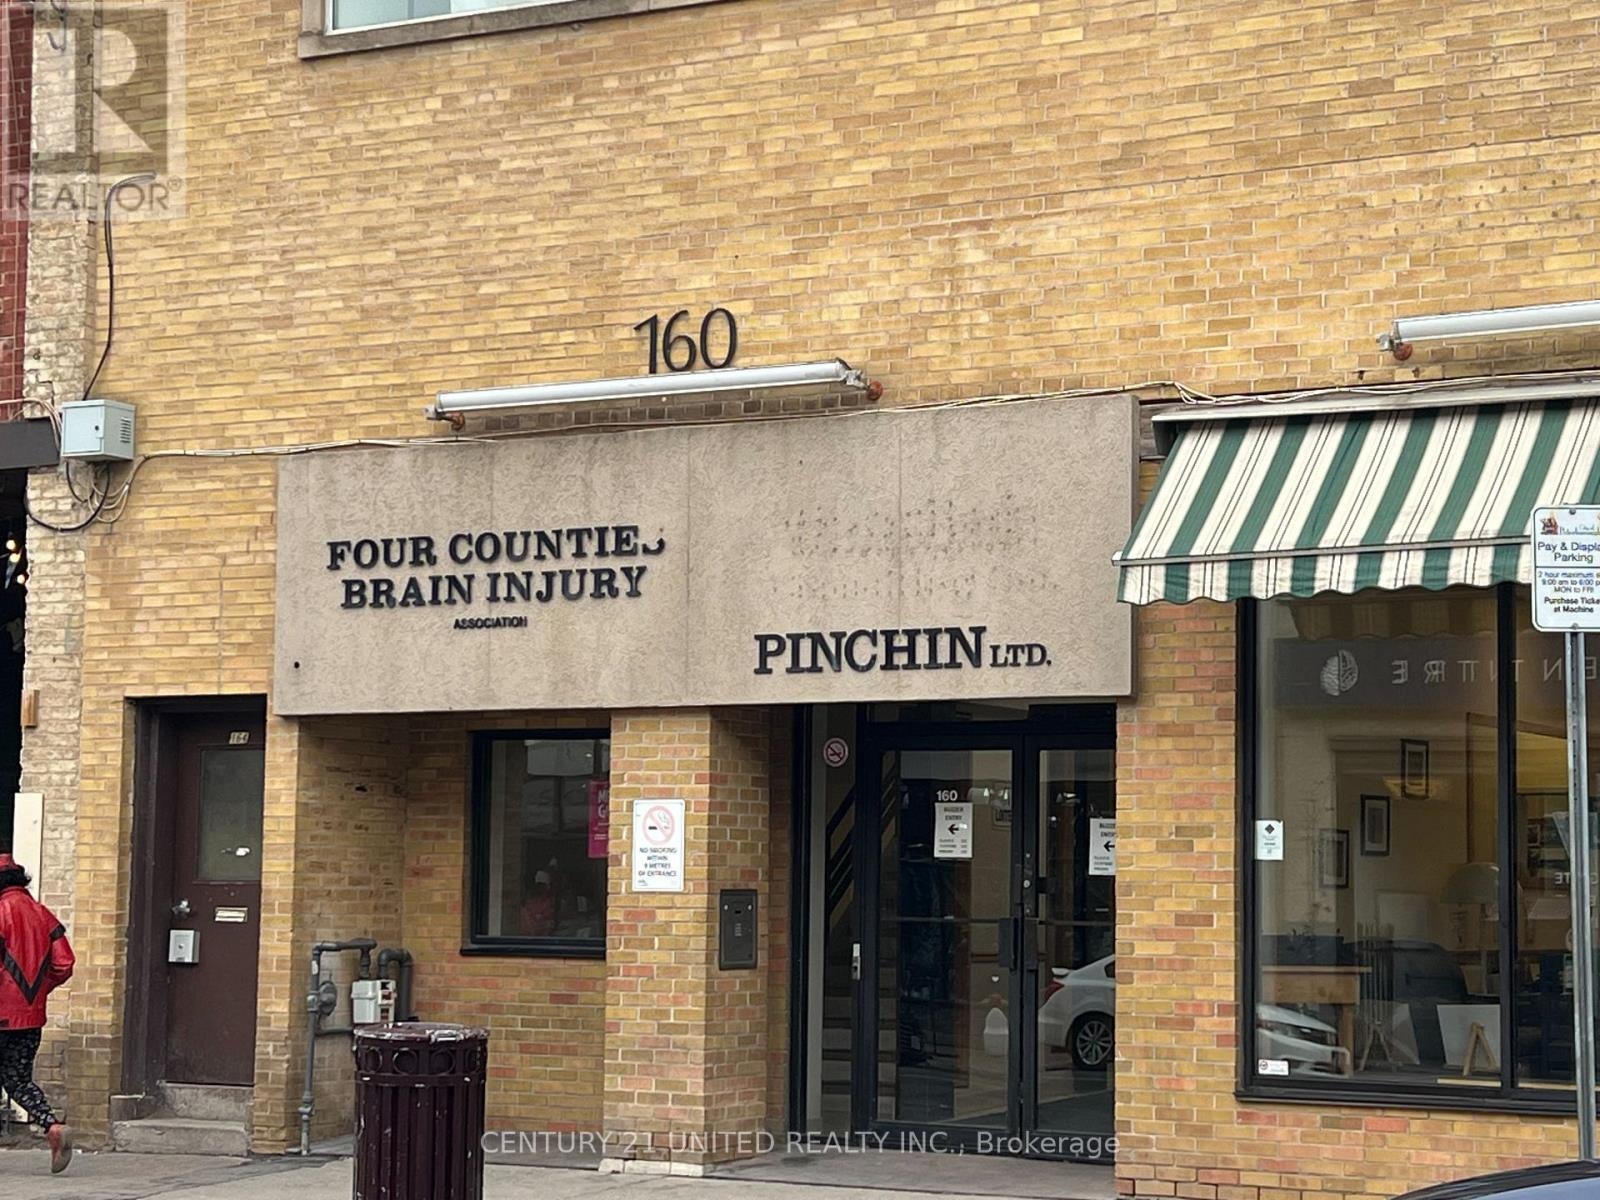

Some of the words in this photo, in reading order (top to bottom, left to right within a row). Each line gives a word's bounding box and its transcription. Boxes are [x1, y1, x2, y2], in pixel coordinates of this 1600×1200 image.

[633, 307, 737, 375] 160
[326, 534, 438, 571] FOUR
[1537, 541, 1557, 553] Pay
[1560, 542, 1568, 551] &
[1554, 552, 1593, 564] Parking
[340, 573, 475, 609] BRAIN
[485, 565, 648, 602] INJURY
[453, 616, 528, 630] ASSOCIATION
[754, 626, 987, 674] PINCHIN
[990, 644, 1052, 668] LTD.
[936, 790, 958, 801] 160
